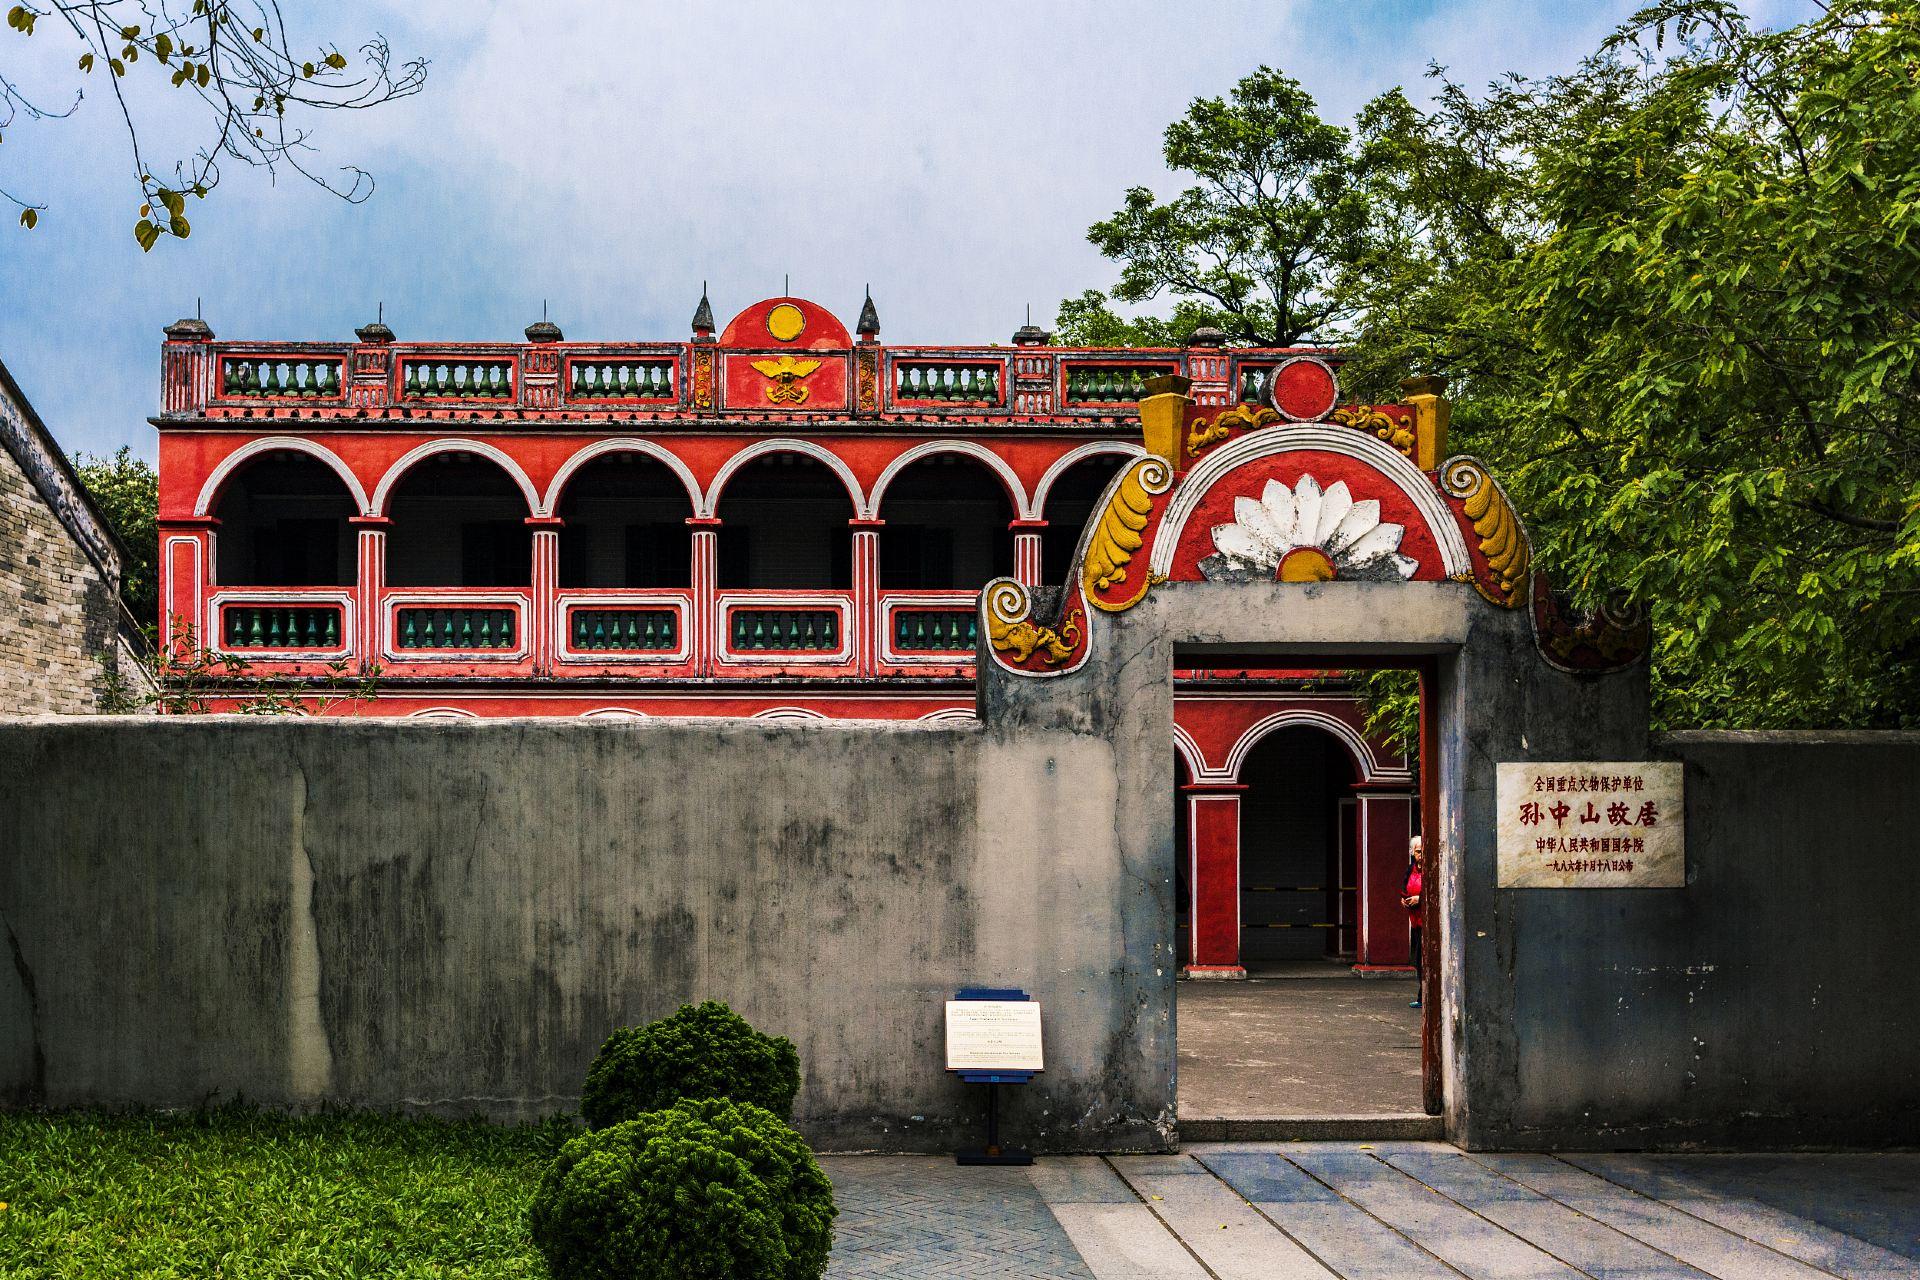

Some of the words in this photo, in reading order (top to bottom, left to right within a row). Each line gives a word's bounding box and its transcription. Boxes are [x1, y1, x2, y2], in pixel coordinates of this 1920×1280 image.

[1533, 775, 1644, 793] 全国重点文物保护单位
[1519, 799, 1658, 830] 孙中山故居
[1535, 836, 1645, 853] 中华人民共和国国务院
[1545, 859, 1634, 873] 一九八六年十月十八日公布
